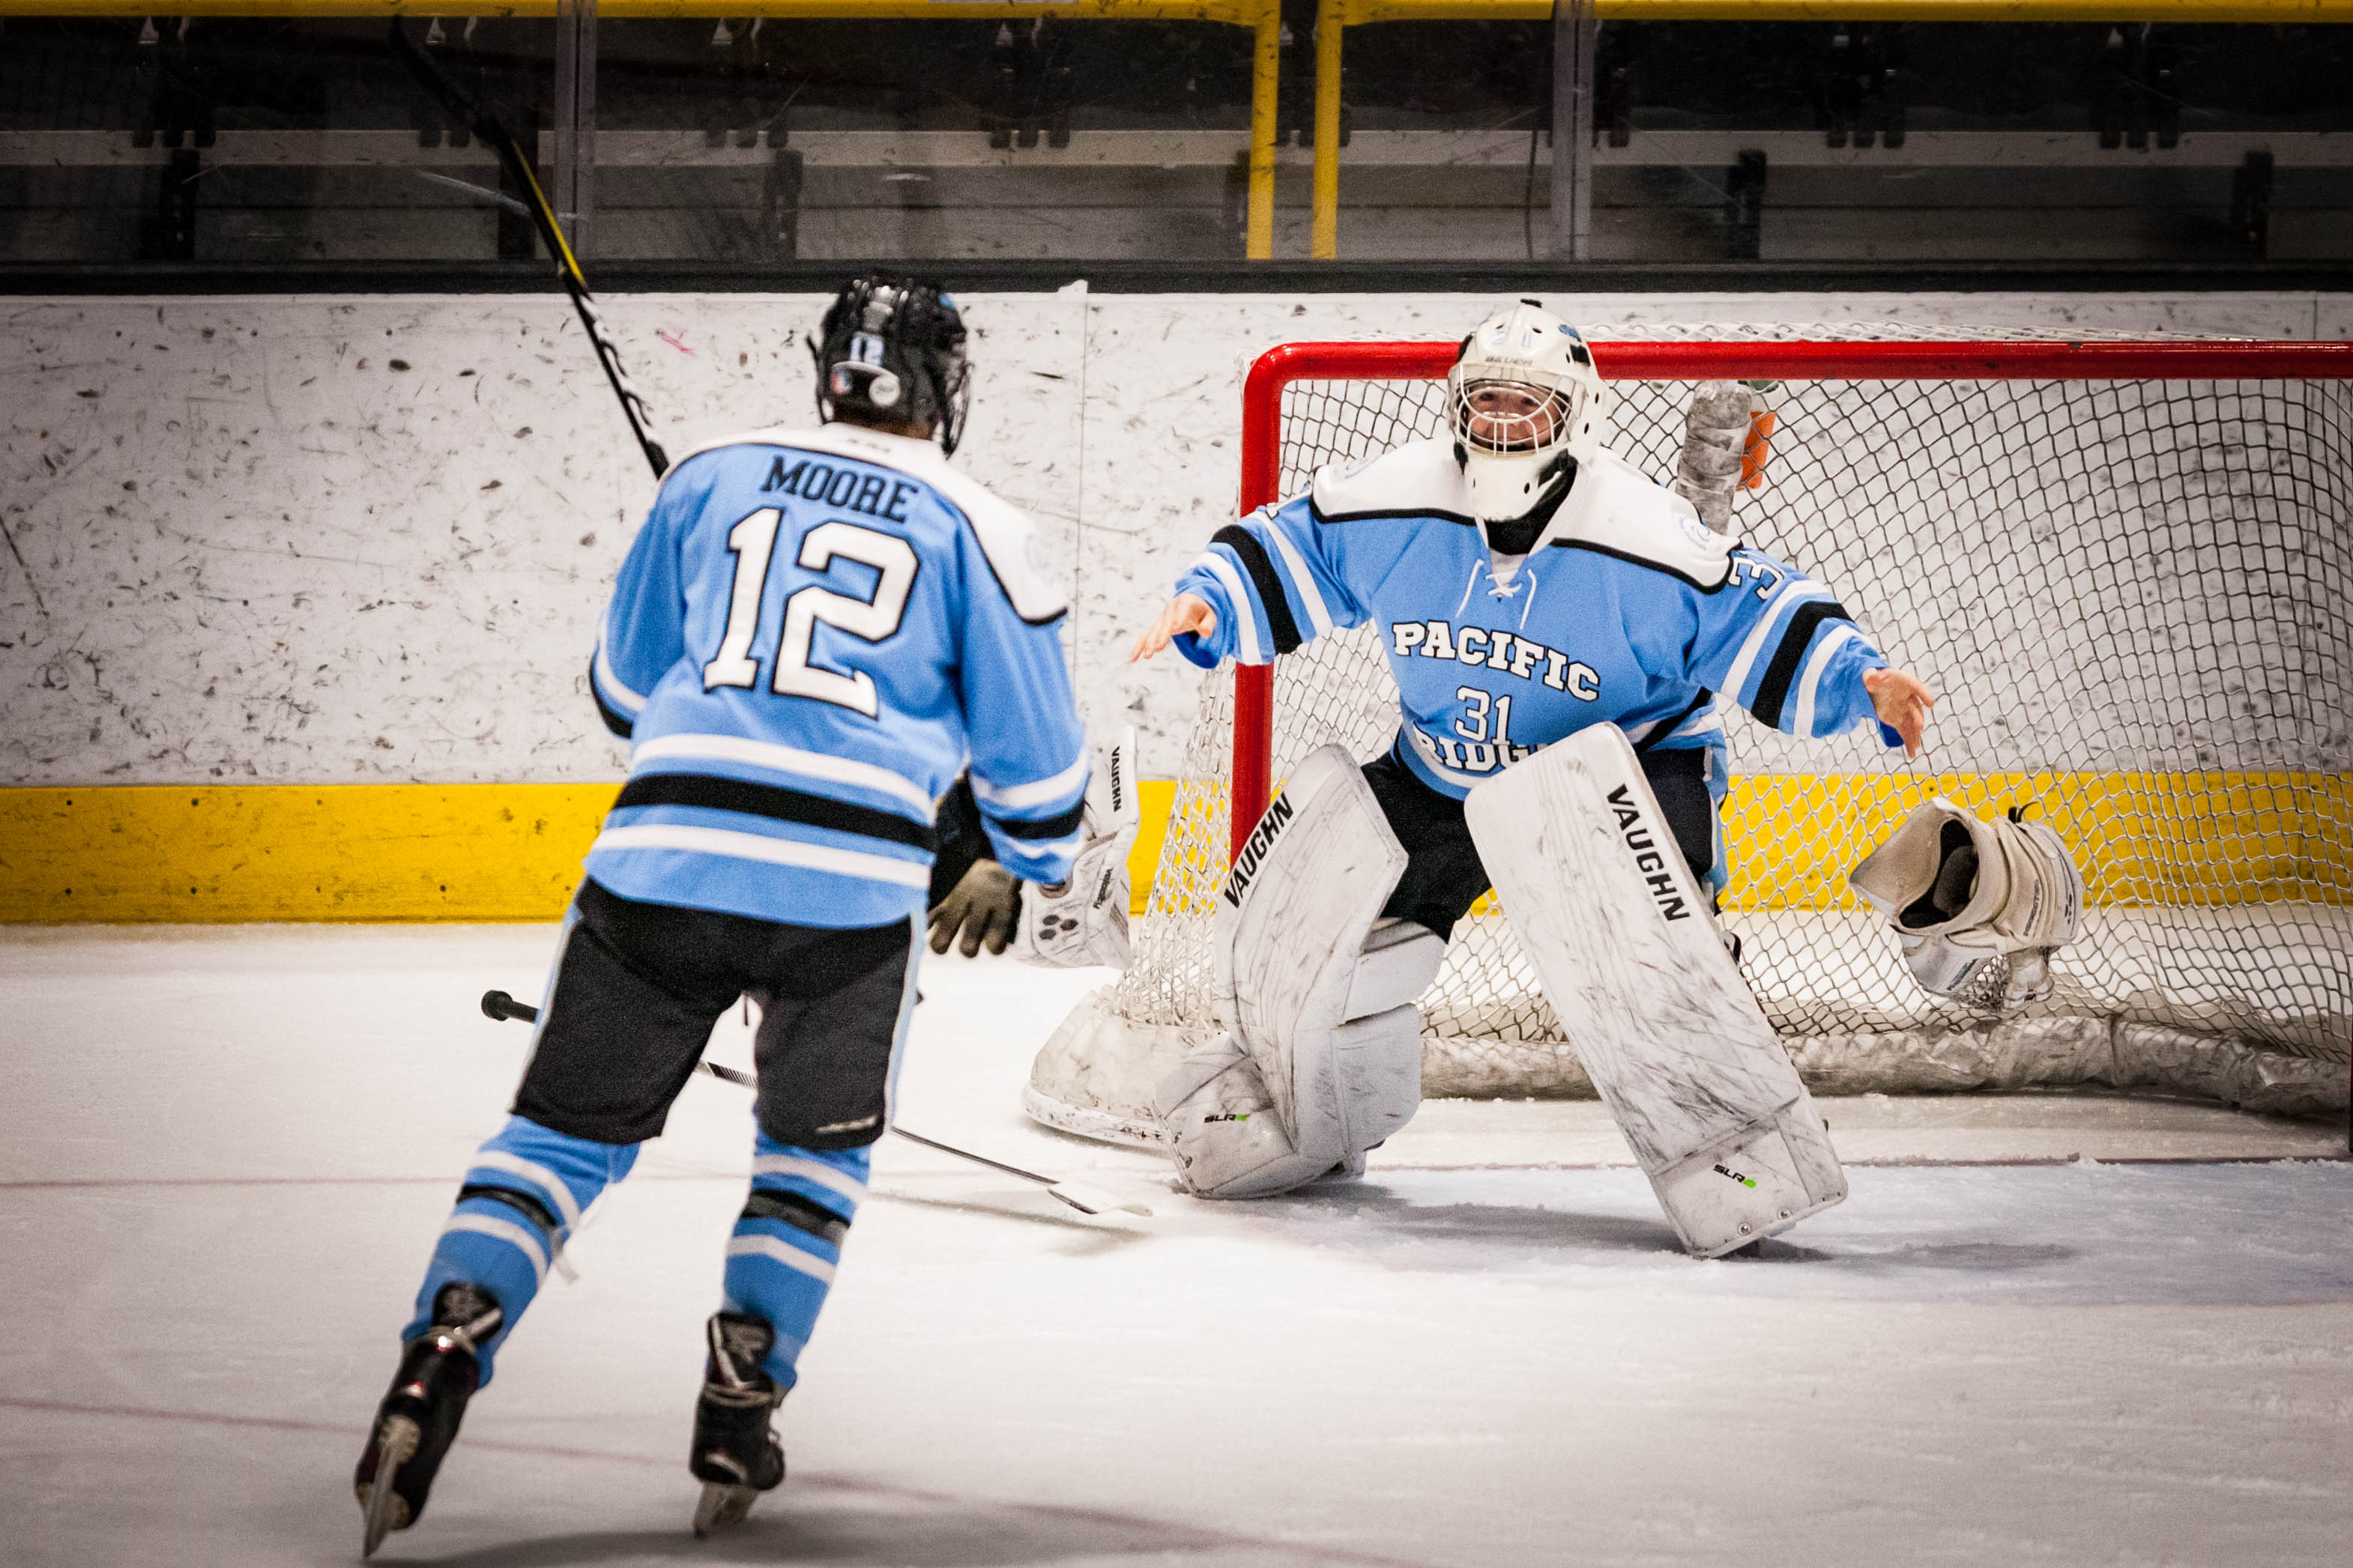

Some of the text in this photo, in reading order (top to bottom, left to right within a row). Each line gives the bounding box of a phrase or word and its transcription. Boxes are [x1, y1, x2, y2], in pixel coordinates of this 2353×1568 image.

[761, 455, 919, 523] MOORE
[704, 506, 922, 721] 12
[1392, 619, 1601, 702] PACIFIC
[1413, 719, 1550, 772] RIDG
[1455, 685, 1512, 745] 31
[1111, 745, 1122, 813] VAUGHN
[1224, 791, 1294, 909] VAUGHN
[1607, 783, 1691, 921] VAUGHN
